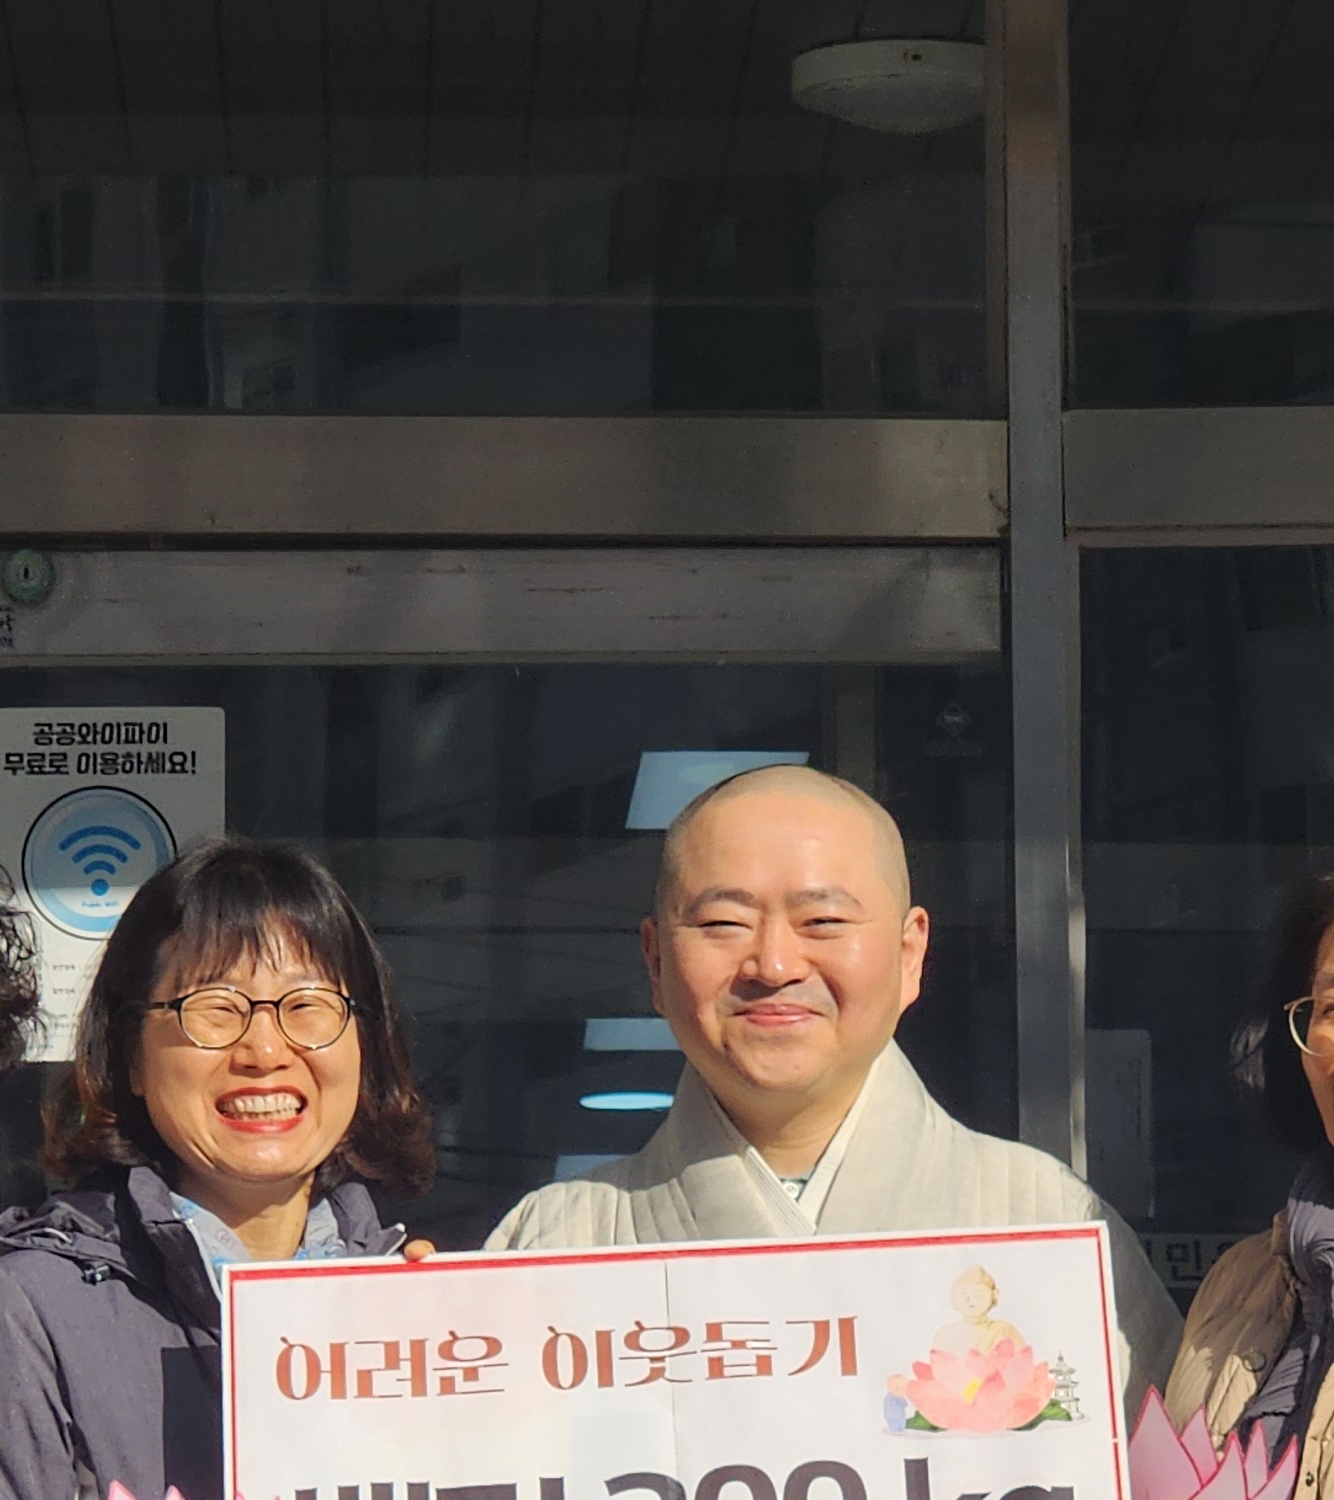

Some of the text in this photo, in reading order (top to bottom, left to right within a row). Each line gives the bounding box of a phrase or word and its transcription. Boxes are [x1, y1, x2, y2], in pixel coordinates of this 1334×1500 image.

[33, 722, 168, 746] 공공와이파이
[4, 751, 197, 776] 무료로 이용하세요!
[274, 1315, 860, 1401] 어려운 이웃돕기
